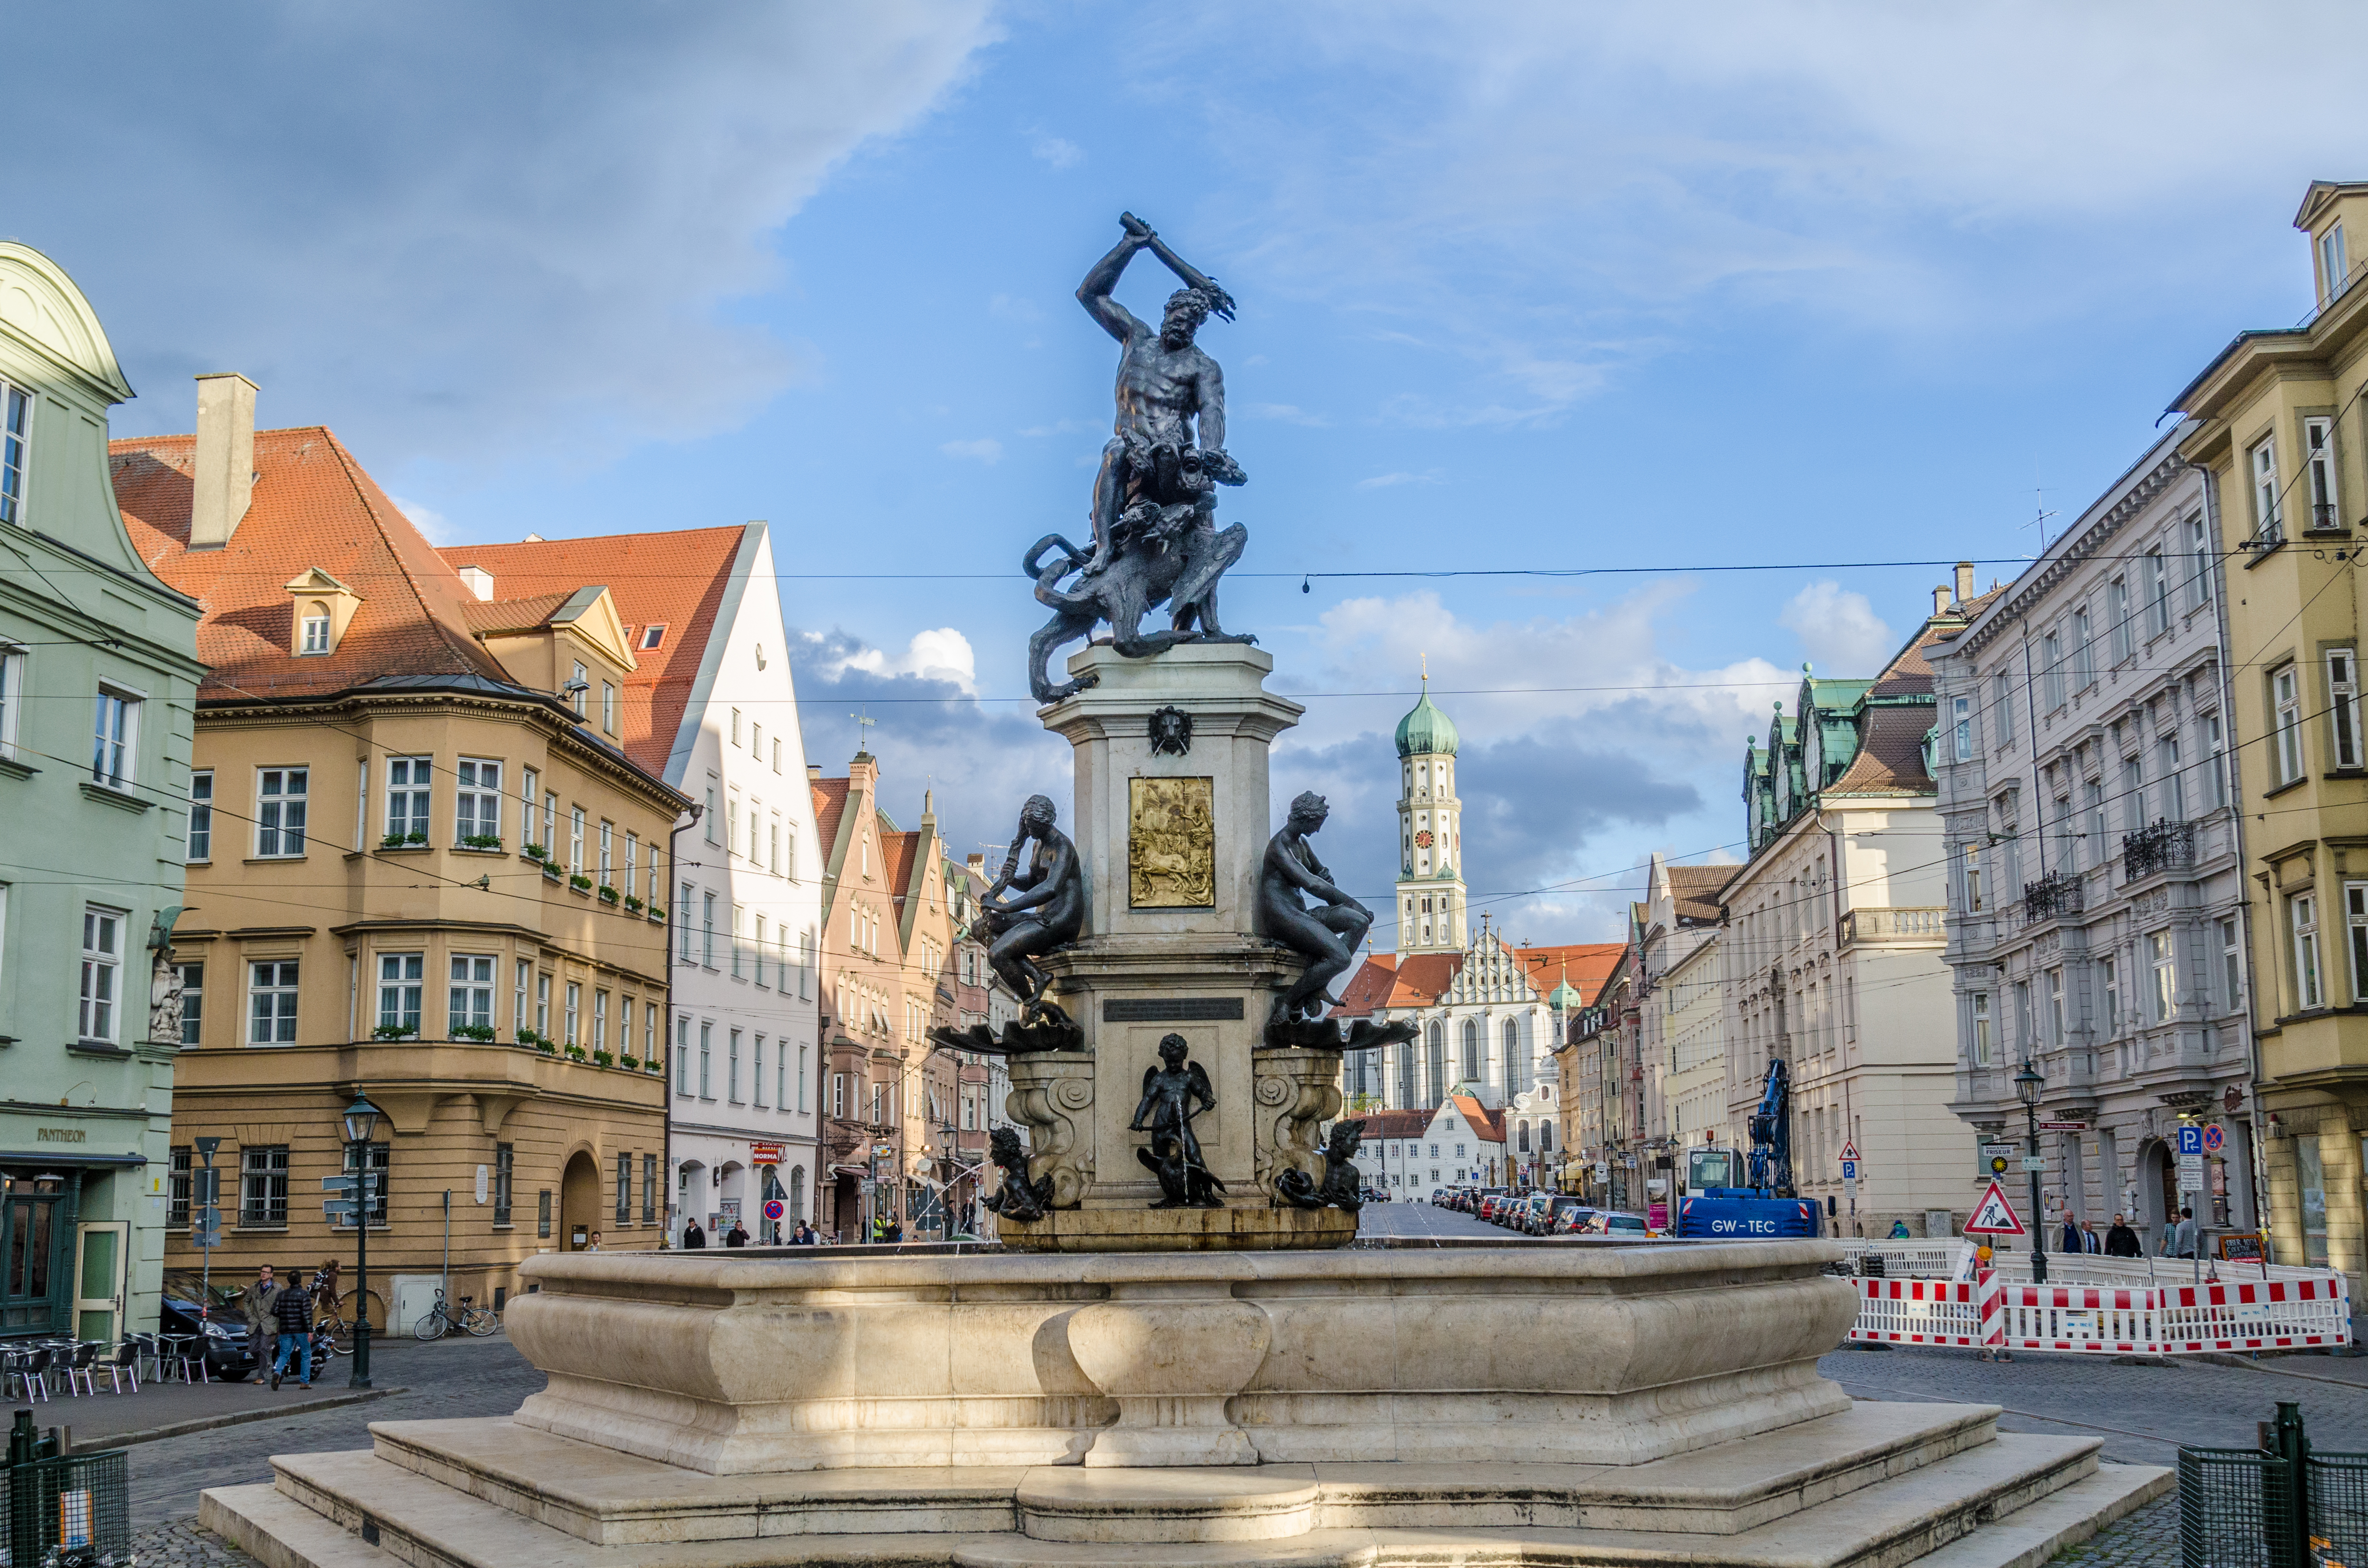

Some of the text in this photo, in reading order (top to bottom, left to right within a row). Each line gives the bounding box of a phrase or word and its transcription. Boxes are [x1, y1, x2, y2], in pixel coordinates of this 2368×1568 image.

[38, 1128, 86, 1142] PANTHEON
[2183, 1130, 2196, 1151] P
[1845, 1164, 1852, 1176] P
